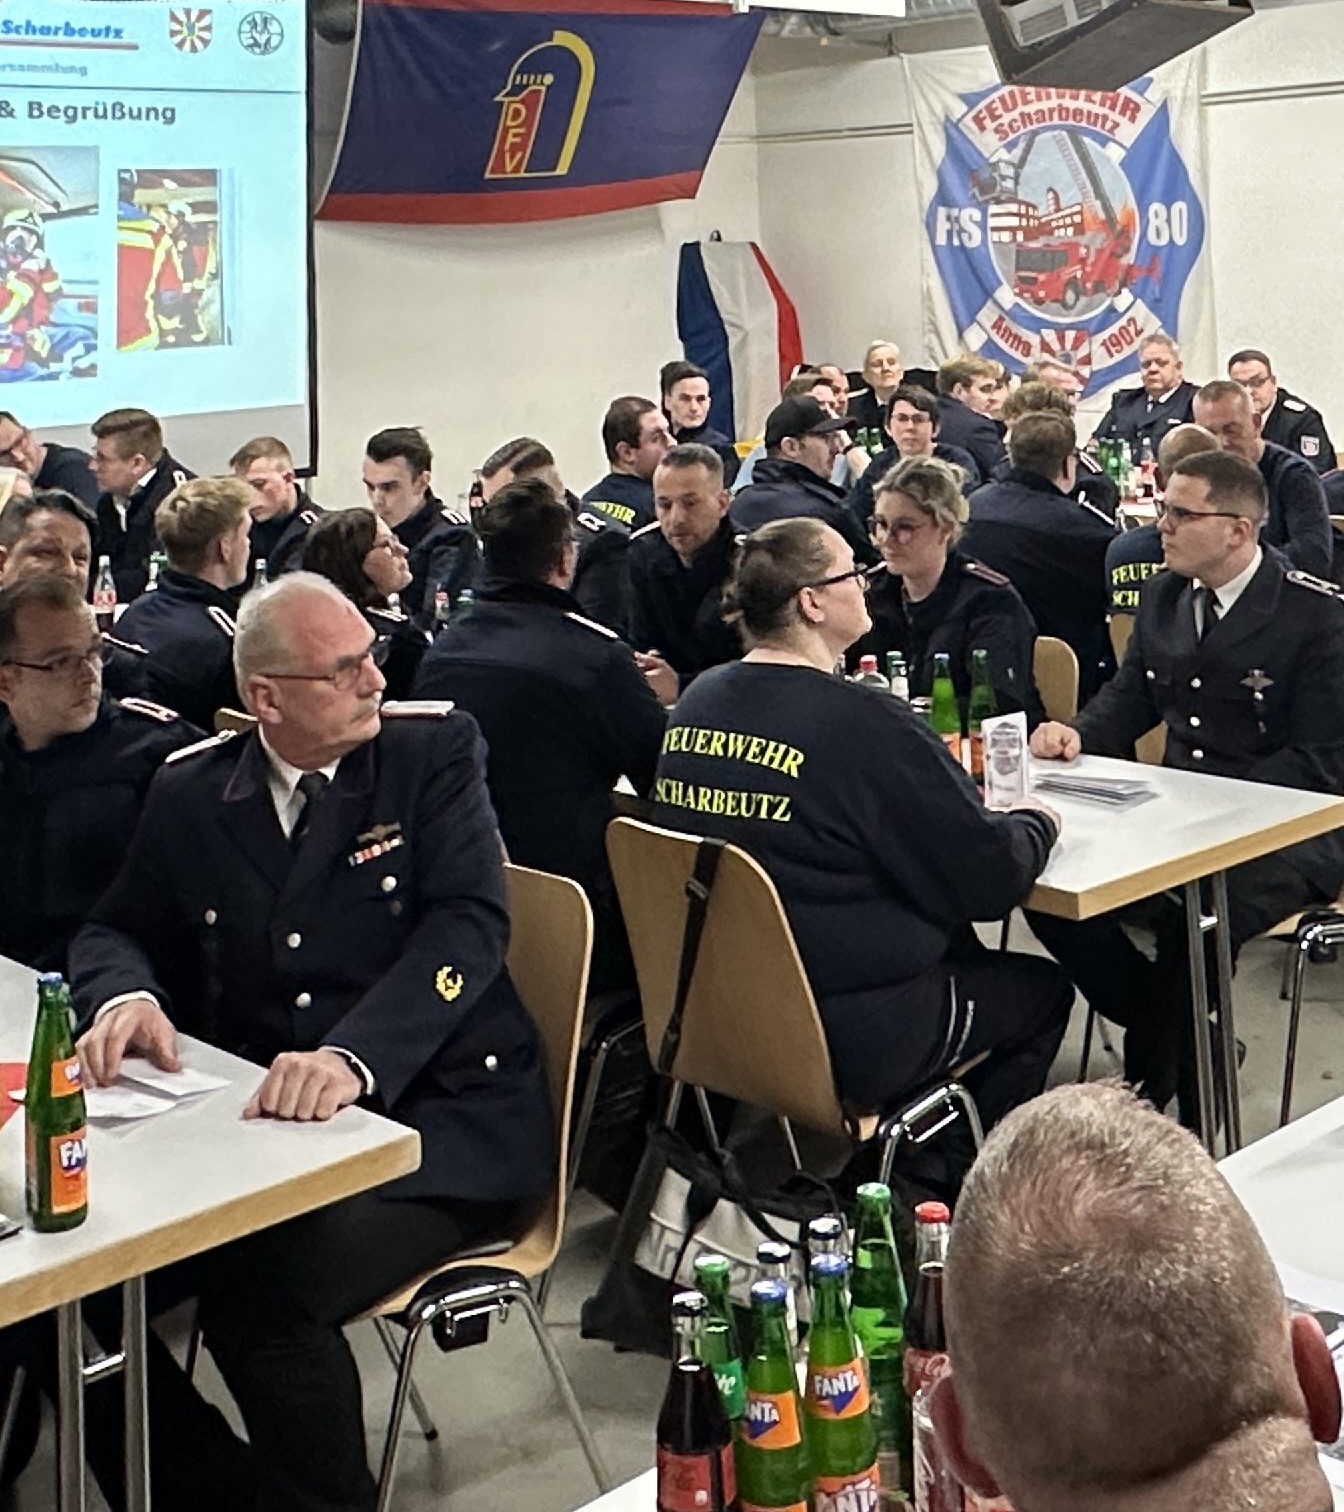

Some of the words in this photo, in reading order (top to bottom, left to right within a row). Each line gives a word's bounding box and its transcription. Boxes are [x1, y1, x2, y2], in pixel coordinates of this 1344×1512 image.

[27, 99, 177, 125] Begrüßung
[992, 103, 1121, 143] Scharbeutz
[504, 102, 527, 174] DFV
[1146, 200, 1188, 246] 80
[991, 313, 1033, 358] Anno
[1100, 316, 1145, 359] 1902
[656, 777, 792, 822] SCHARBEUTZ
[814, 1370, 861, 1397] FANTA
